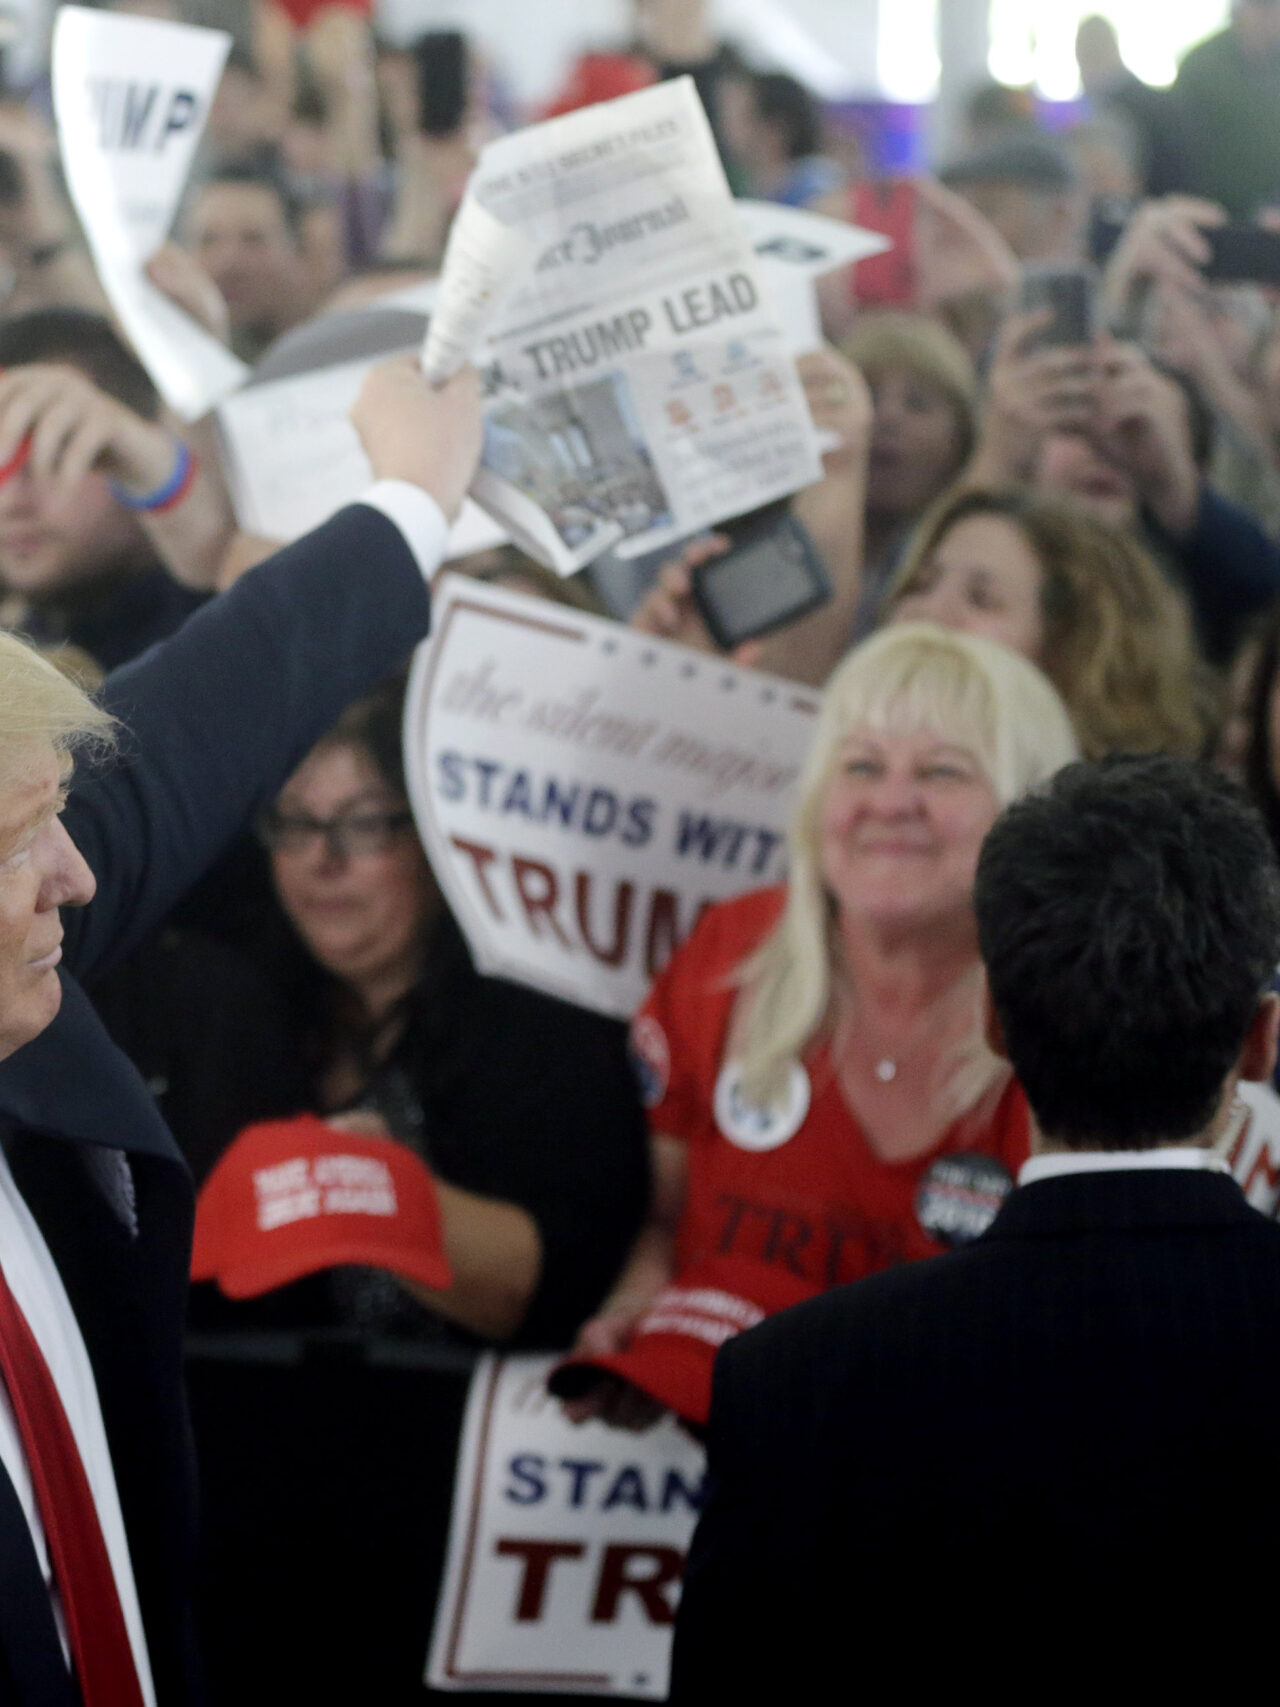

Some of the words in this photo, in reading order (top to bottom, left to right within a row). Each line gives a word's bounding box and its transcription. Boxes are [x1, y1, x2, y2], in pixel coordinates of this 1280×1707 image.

[523, 308, 652, 381] TRUMP
[663, 271, 760, 335] LEAD
[437, 750, 655, 849] STANDS
[675, 810, 790, 880] WIT
